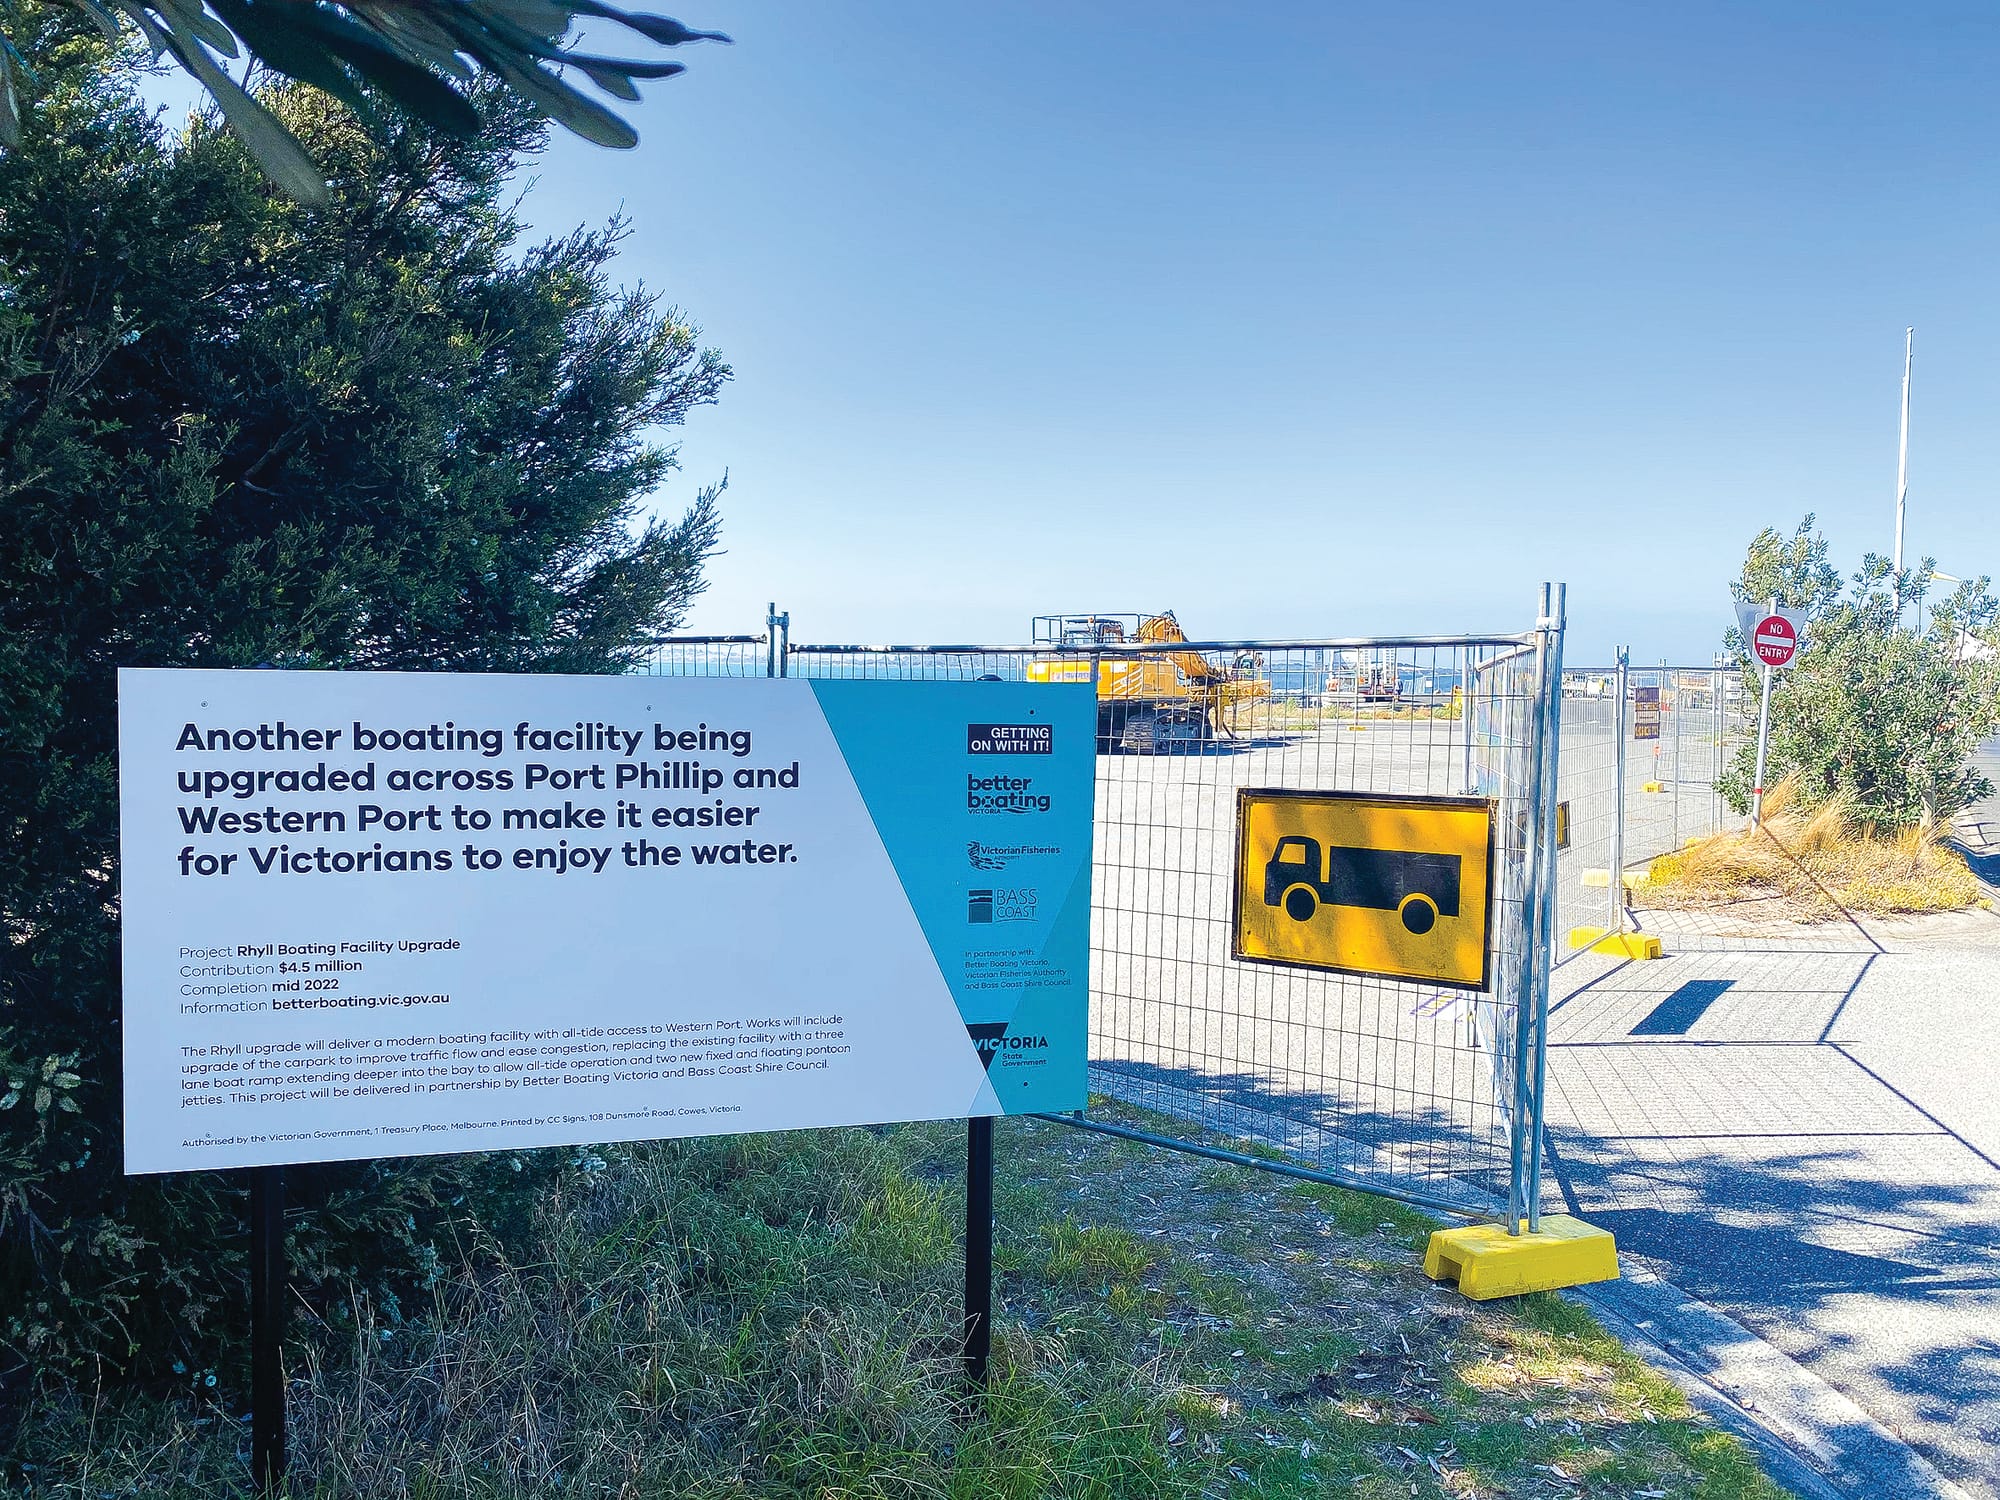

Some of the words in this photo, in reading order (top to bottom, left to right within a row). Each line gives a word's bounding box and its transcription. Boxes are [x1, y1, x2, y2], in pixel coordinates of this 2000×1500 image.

[1770, 623, 1783, 635] NO
[1760, 646, 1789, 659] ENTRY
[175, 721, 342, 751] Another
[353, 721, 503, 757] boating
[513, 721, 644, 757] facility
[654, 722, 751, 757] being
[991, 727, 1049, 738] GETTING
[971, 740, 991, 751] ON
[995, 740, 1029, 751] WITH
[1033, 740, 1049, 751] IT!
[177, 762, 375, 799] upgraded
[386, 769, 514, 791] across
[525, 763, 606, 790] Port
[615, 760, 724, 794] Phillip
[732, 761, 799, 789] and
[968, 774, 1032, 790] better
[968, 791, 1051, 812] boating
[177, 806, 345, 834] Western
[358, 804, 442, 832] Port
[450, 804, 492, 831] to
[503, 801, 606, 829] make
[616, 799, 642, 828] it
[651, 798, 760, 828] easier
[177, 846, 237, 876] for
[247, 842, 453, 874] Victorians
[461, 844, 502, 870] to
[512, 839, 612, 874] enjoy
[621, 838, 681, 867] the
[690, 839, 797, 865] water.
[981, 846, 1020, 854] Victorian
[1021, 846, 1060, 854] Fisheries
[996, 889, 1037, 905] BASS
[996, 906, 1037, 918] COAST
[179, 946, 233, 960] Project
[237, 943, 273, 958] Rhyll
[278, 942, 336, 956] Boating
[340, 940, 394, 954] Facility
[398, 938, 460, 953] Upgrade
[974, 949, 1017, 960] partnership
[179, 963, 274, 978] Contribution
[279, 961, 310, 975] $4.5
[314, 959, 362, 972] million
[990, 960, 1018, 968] Boating
[965, 971, 998, 979] Victorian
[1033, 969, 1067, 977] Authority
[180, 981, 267, 997] Completion
[272, 979, 300, 992] mid
[304, 978, 339, 991] 2022
[180, 1000, 267, 1014] Information
[272, 993, 449, 1010] betterboating.vic.gov.au
[180, 1046, 206, 1057] The
[210, 1043, 241, 1057] Rhyll
[245, 1041, 301, 1055] upgrade
[304, 1039, 324, 1050] will
[328, 1038, 370, 1050] deliver
[373, 1039, 382, 1048] a
[386, 1035, 435, 1047] modern
[439, 1033, 486, 1045] boating
[490, 1030, 530, 1042] facility
[533, 1028, 559, 1040] with
[561, 1026, 604, 1039] all-tide
[606, 1026, 647, 1036] access
[650, 1024, 663, 1034] to
[665, 1022, 712, 1033] Western
[716, 1020, 743, 1030] Port.
[745, 1017, 781, 1028] Works
[783, 1016, 800, 1026] will
[803, 1014, 843, 1025] include
[972, 1035, 1049, 1050] VICTORIA
[181, 1060, 238, 1075] upgrade
[242, 1058, 256, 1070] of
[258, 1058, 281, 1069] the
[284, 1055, 336, 1069] carpark
[339, 1055, 353, 1065] to
[356, 1054, 407, 1065] improve
[410, 1049, 449, 1061] traffic
[452, 1048, 478, 1059] flow
[480, 1046, 504, 1058] and
[508, 1047, 537, 1056] ease
[540, 1042, 608, 1056] congestion,
[612, 1039, 666, 1052] replacing
[669, 1037, 689, 1048] the
[691, 1035, 735, 1047] existing
[738, 1032, 775, 1044] facility
[778, 1030, 801, 1041] with
[804, 1032, 812, 1040] a
[814, 1030, 844, 1039] three
[181, 1079, 210, 1090] lane
[213, 1077, 245, 1088] boat
[248, 1076, 283, 1086] ramp
[286, 1071, 350, 1084] extending
[353, 1069, 398, 1081] deeper
[401, 1067, 425, 1078] into
[427, 1066, 448, 1076] the
[451, 1064, 474, 1076] bay
[477, 1064, 490, 1074] to
[492, 1062, 523, 1073] allow
[526, 1059, 567, 1071] all-tide
[570, 1056, 627, 1070] operation
[629, 1054, 652, 1065] and
[655, 1054, 677, 1064] two
[679, 1053, 703, 1062] new
[705, 1049, 733, 1061] fixed
[735, 1048, 758, 1059] and
[760, 1046, 802, 1058] floating
[805, 1043, 851, 1057] pontoon
[1002, 1059, 1047, 1067] Government
[180, 1094, 226, 1109] jetties.
[229, 1092, 256, 1103] This
[260, 1089, 306, 1104] project
[309, 1087, 329, 1098] will
[333, 1086, 349, 1097] be
[352, 1082, 410, 1096] delivered
[414, 1082, 425, 1093] in
[428, 1078, 501, 1093] partnership
[504, 1077, 519, 1089] by
[522, 1076, 560, 1087] Better
[563, 1072, 610, 1084] Boating
[613, 1069, 658, 1081] Victoria
[661, 1067, 685, 1078] and
[687, 1067, 715, 1077] Bass
[718, 1064, 752, 1075] Coast
[755, 1062, 783, 1073] Shire
[786, 1058, 829, 1071] Council.
[181, 1135, 234, 1147] Authorised
[236, 1135, 248, 1145] by
[250, 1135, 266, 1143] the
[268, 1133, 311, 1141] Victorian
[381, 1126, 420, 1135] Treasury
[500, 1117, 532, 1127] Printed
[534, 1117, 545, 1125] by
[546, 1115, 560, 1124] CC
[588, 1112, 603, 1121] 108
[605, 1109, 650, 1120] Dunsmore
[651, 1108, 676, 1117] Road,
[677, 1107, 707, 1116] Cowes,
